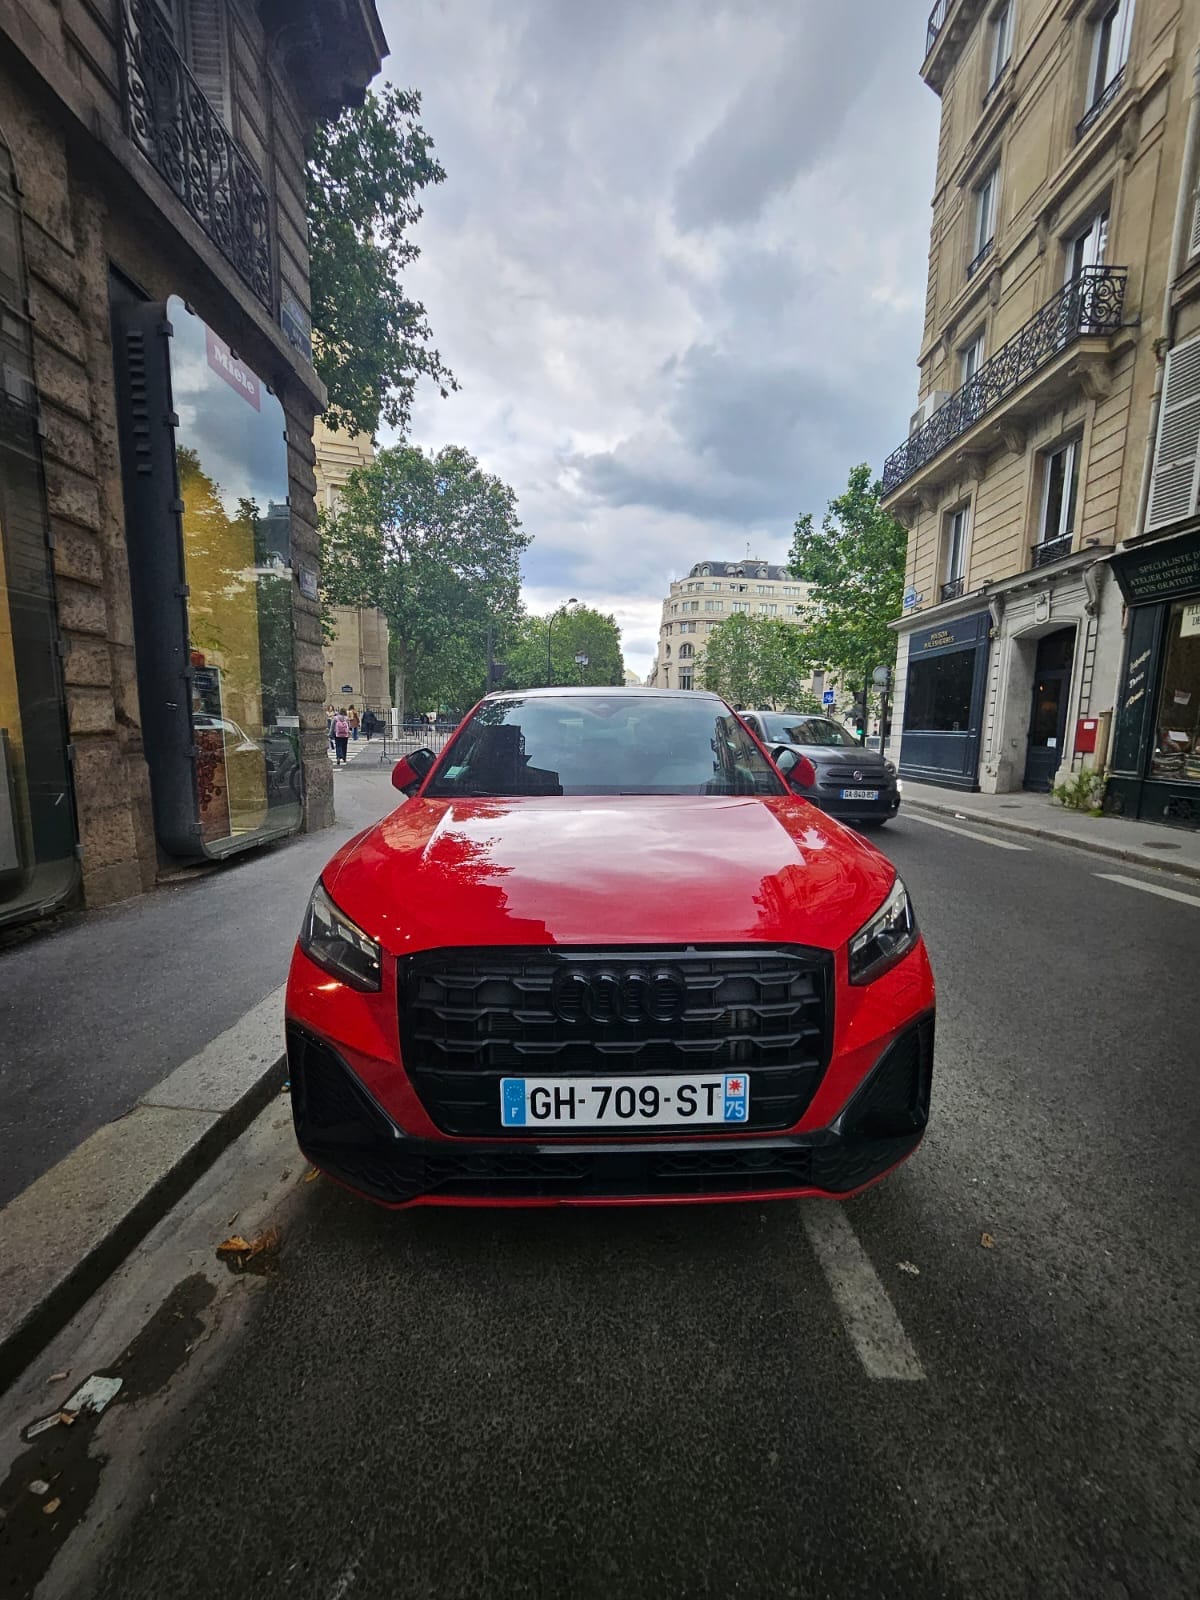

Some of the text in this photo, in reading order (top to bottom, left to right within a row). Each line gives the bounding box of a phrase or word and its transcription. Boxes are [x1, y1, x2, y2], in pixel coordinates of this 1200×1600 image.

[213, 344, 255, 395] Miele
[1129, 572, 1162, 587] ATELIER
[1157, 575, 1193, 590] GRATUIT
[530, 1083, 721, 1119] GH-709-ST
[511, 1107, 519, 1118] F
[726, 1101, 744, 1118] 75
